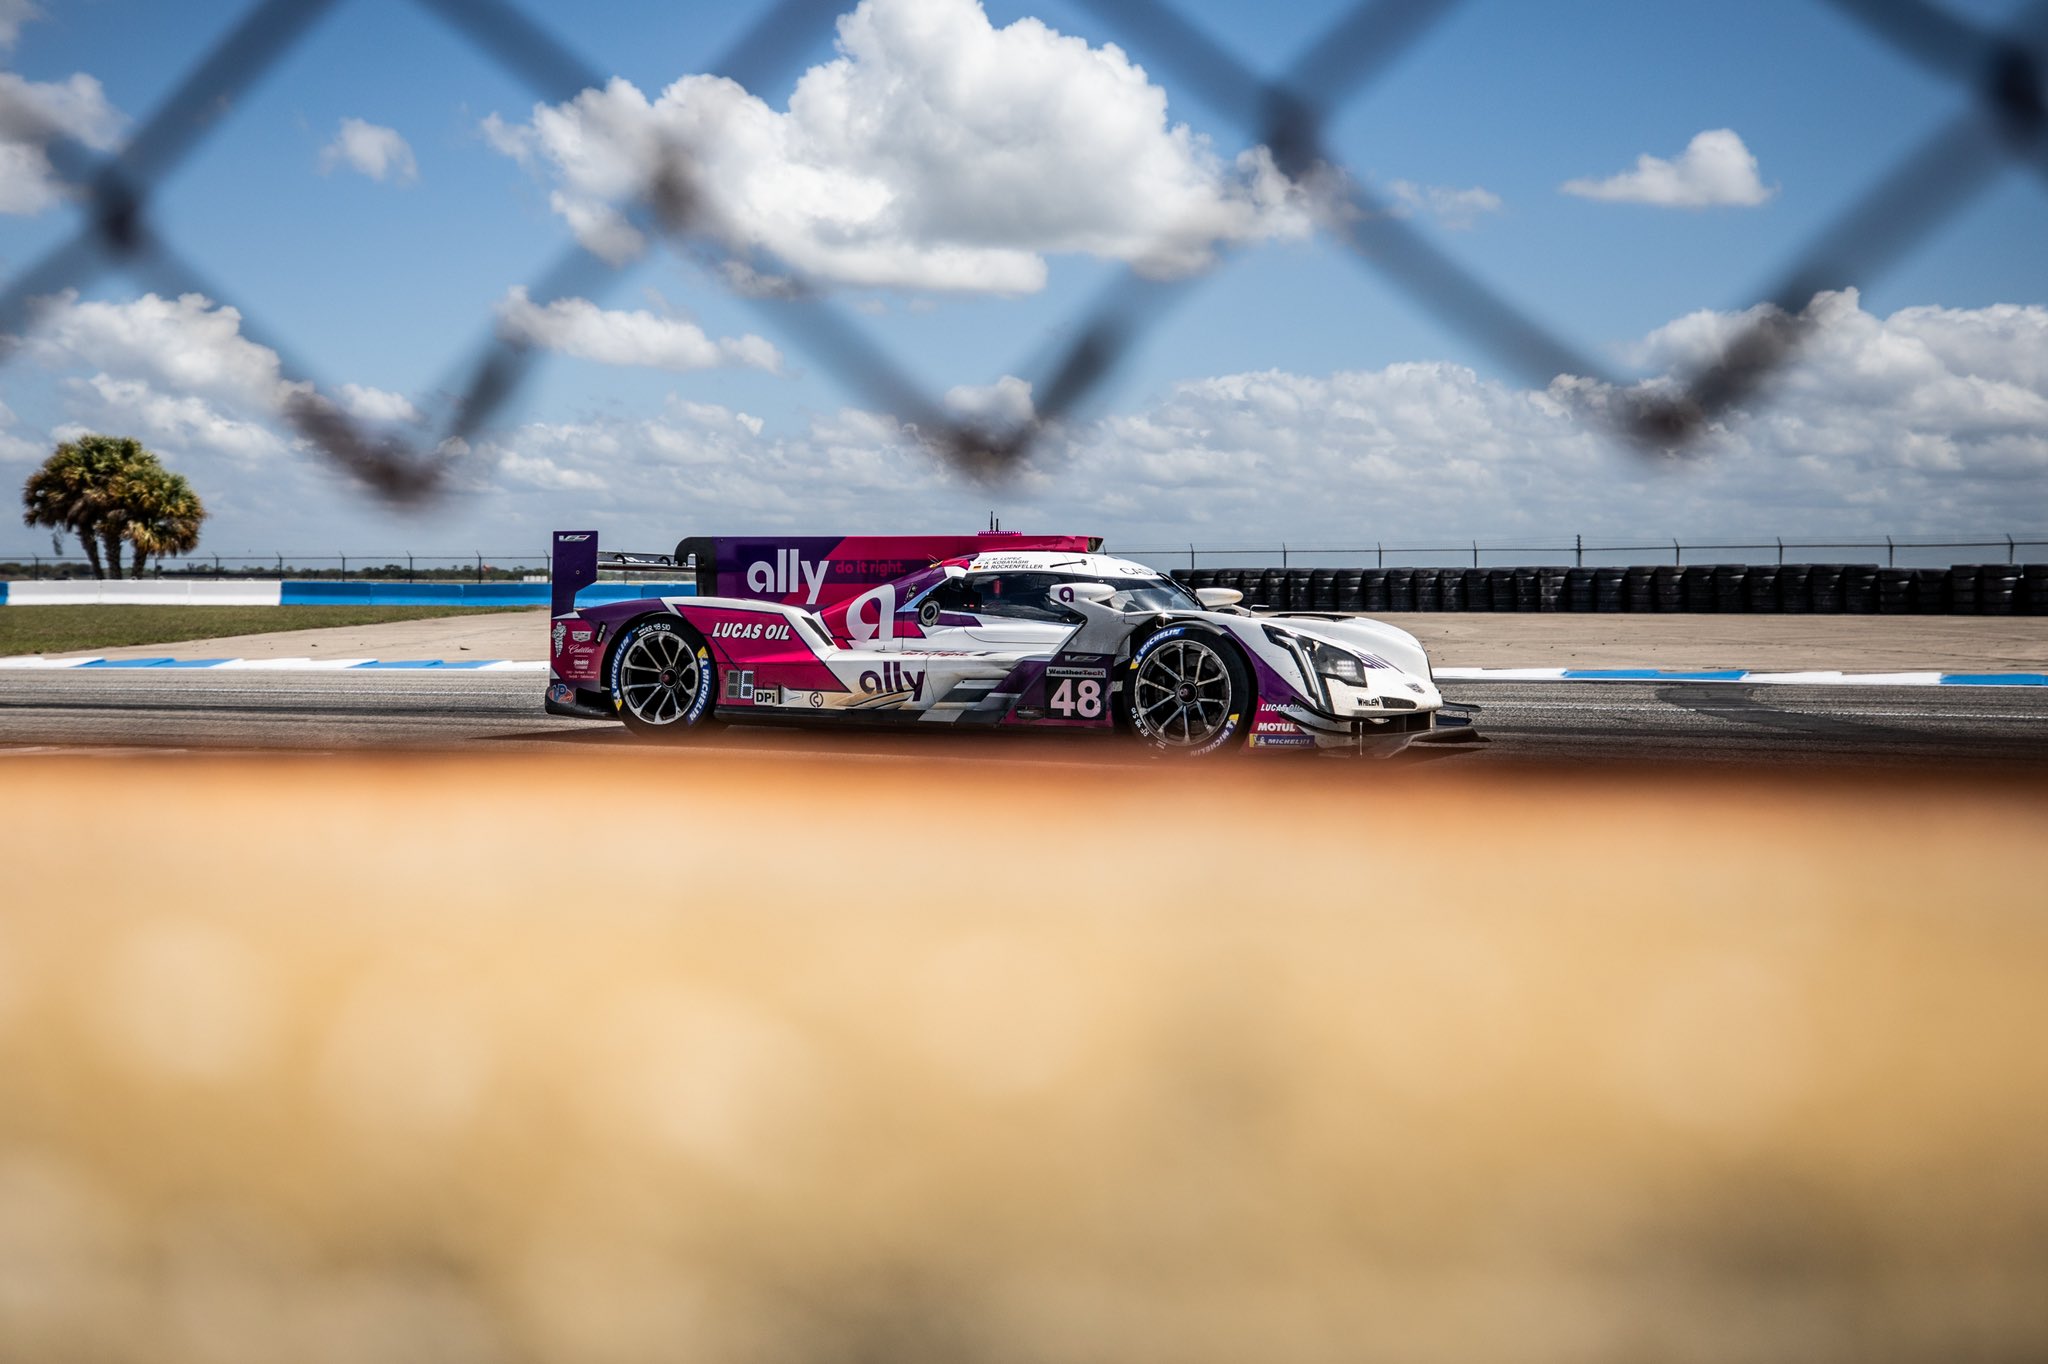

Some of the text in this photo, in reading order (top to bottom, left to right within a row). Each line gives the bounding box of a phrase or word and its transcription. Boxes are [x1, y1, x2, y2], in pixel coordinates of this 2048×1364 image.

[747, 549, 830, 604] ally
[836, 561, 853, 574] do
[857, 560, 867, 573] it
[712, 622, 791, 640] LUCAS OIL
[1140, 628, 1181, 654] MICHELIN
[568, 644, 594, 654] Cadillac
[611, 636, 629, 689] MICHELIN
[690, 668, 710, 720] MICHELIN
[859, 662, 925, 702] ally
[756, 692, 775, 704] DPi
[1050, 678, 1101, 718] 48
[1260, 704, 1288, 712] LUCAS
[1258, 722, 1296, 732] MOTUL
[1190, 730, 1230, 757] MICHELIN
